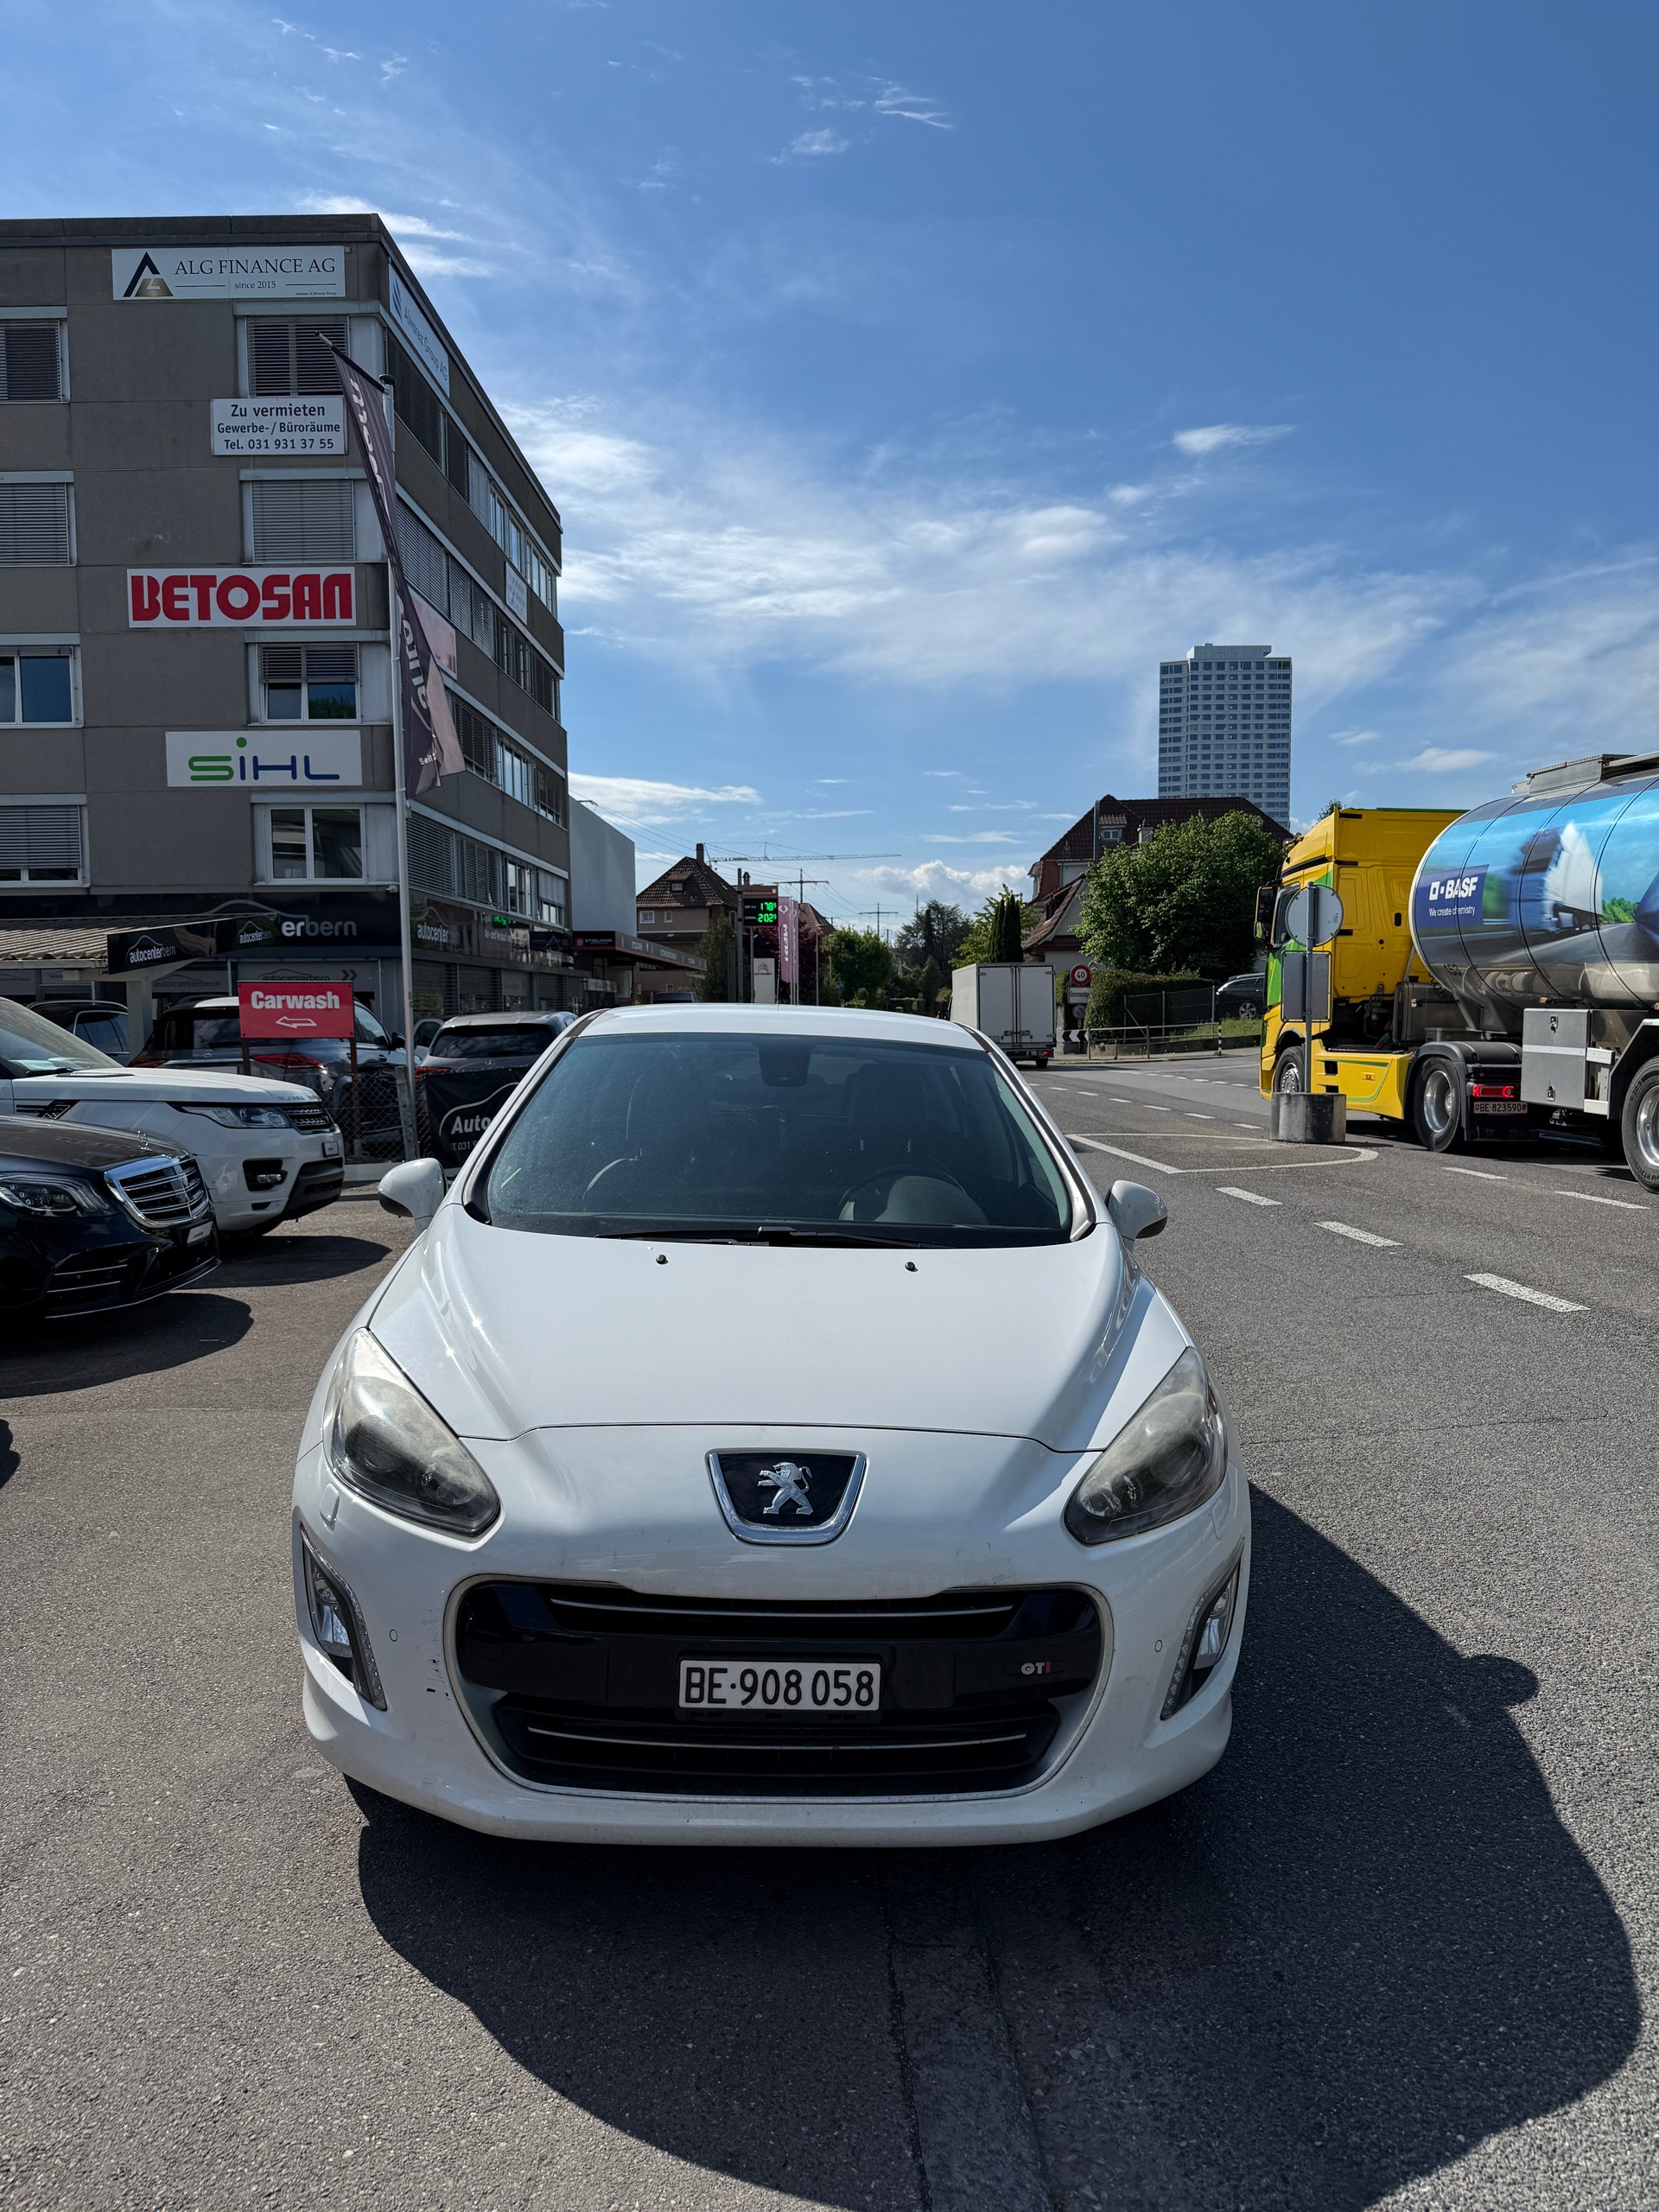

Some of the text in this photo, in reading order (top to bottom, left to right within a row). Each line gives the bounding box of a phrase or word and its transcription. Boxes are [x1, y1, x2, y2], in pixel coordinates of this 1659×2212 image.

[175, 257, 335, 275] ALG FINANCE AG
[234, 281, 256, 289] since
[404, 307, 448, 381] Alvarez Group AG
[231, 404, 325, 417] Zu vermieten
[279, 422, 340, 433] Büroräume
[225, 438, 334, 449] Tel. 031 931 37 55
[130, 574, 353, 621] BETOSAN
[1445, 877, 1478, 899] BASF
[1429, 907, 1436, 916] We
[1437, 907, 1452, 916] create
[130, 945, 175, 963] autocenterbern
[251, 990, 340, 1009] Carwash
[1479, 1103, 1490, 1112] BE
